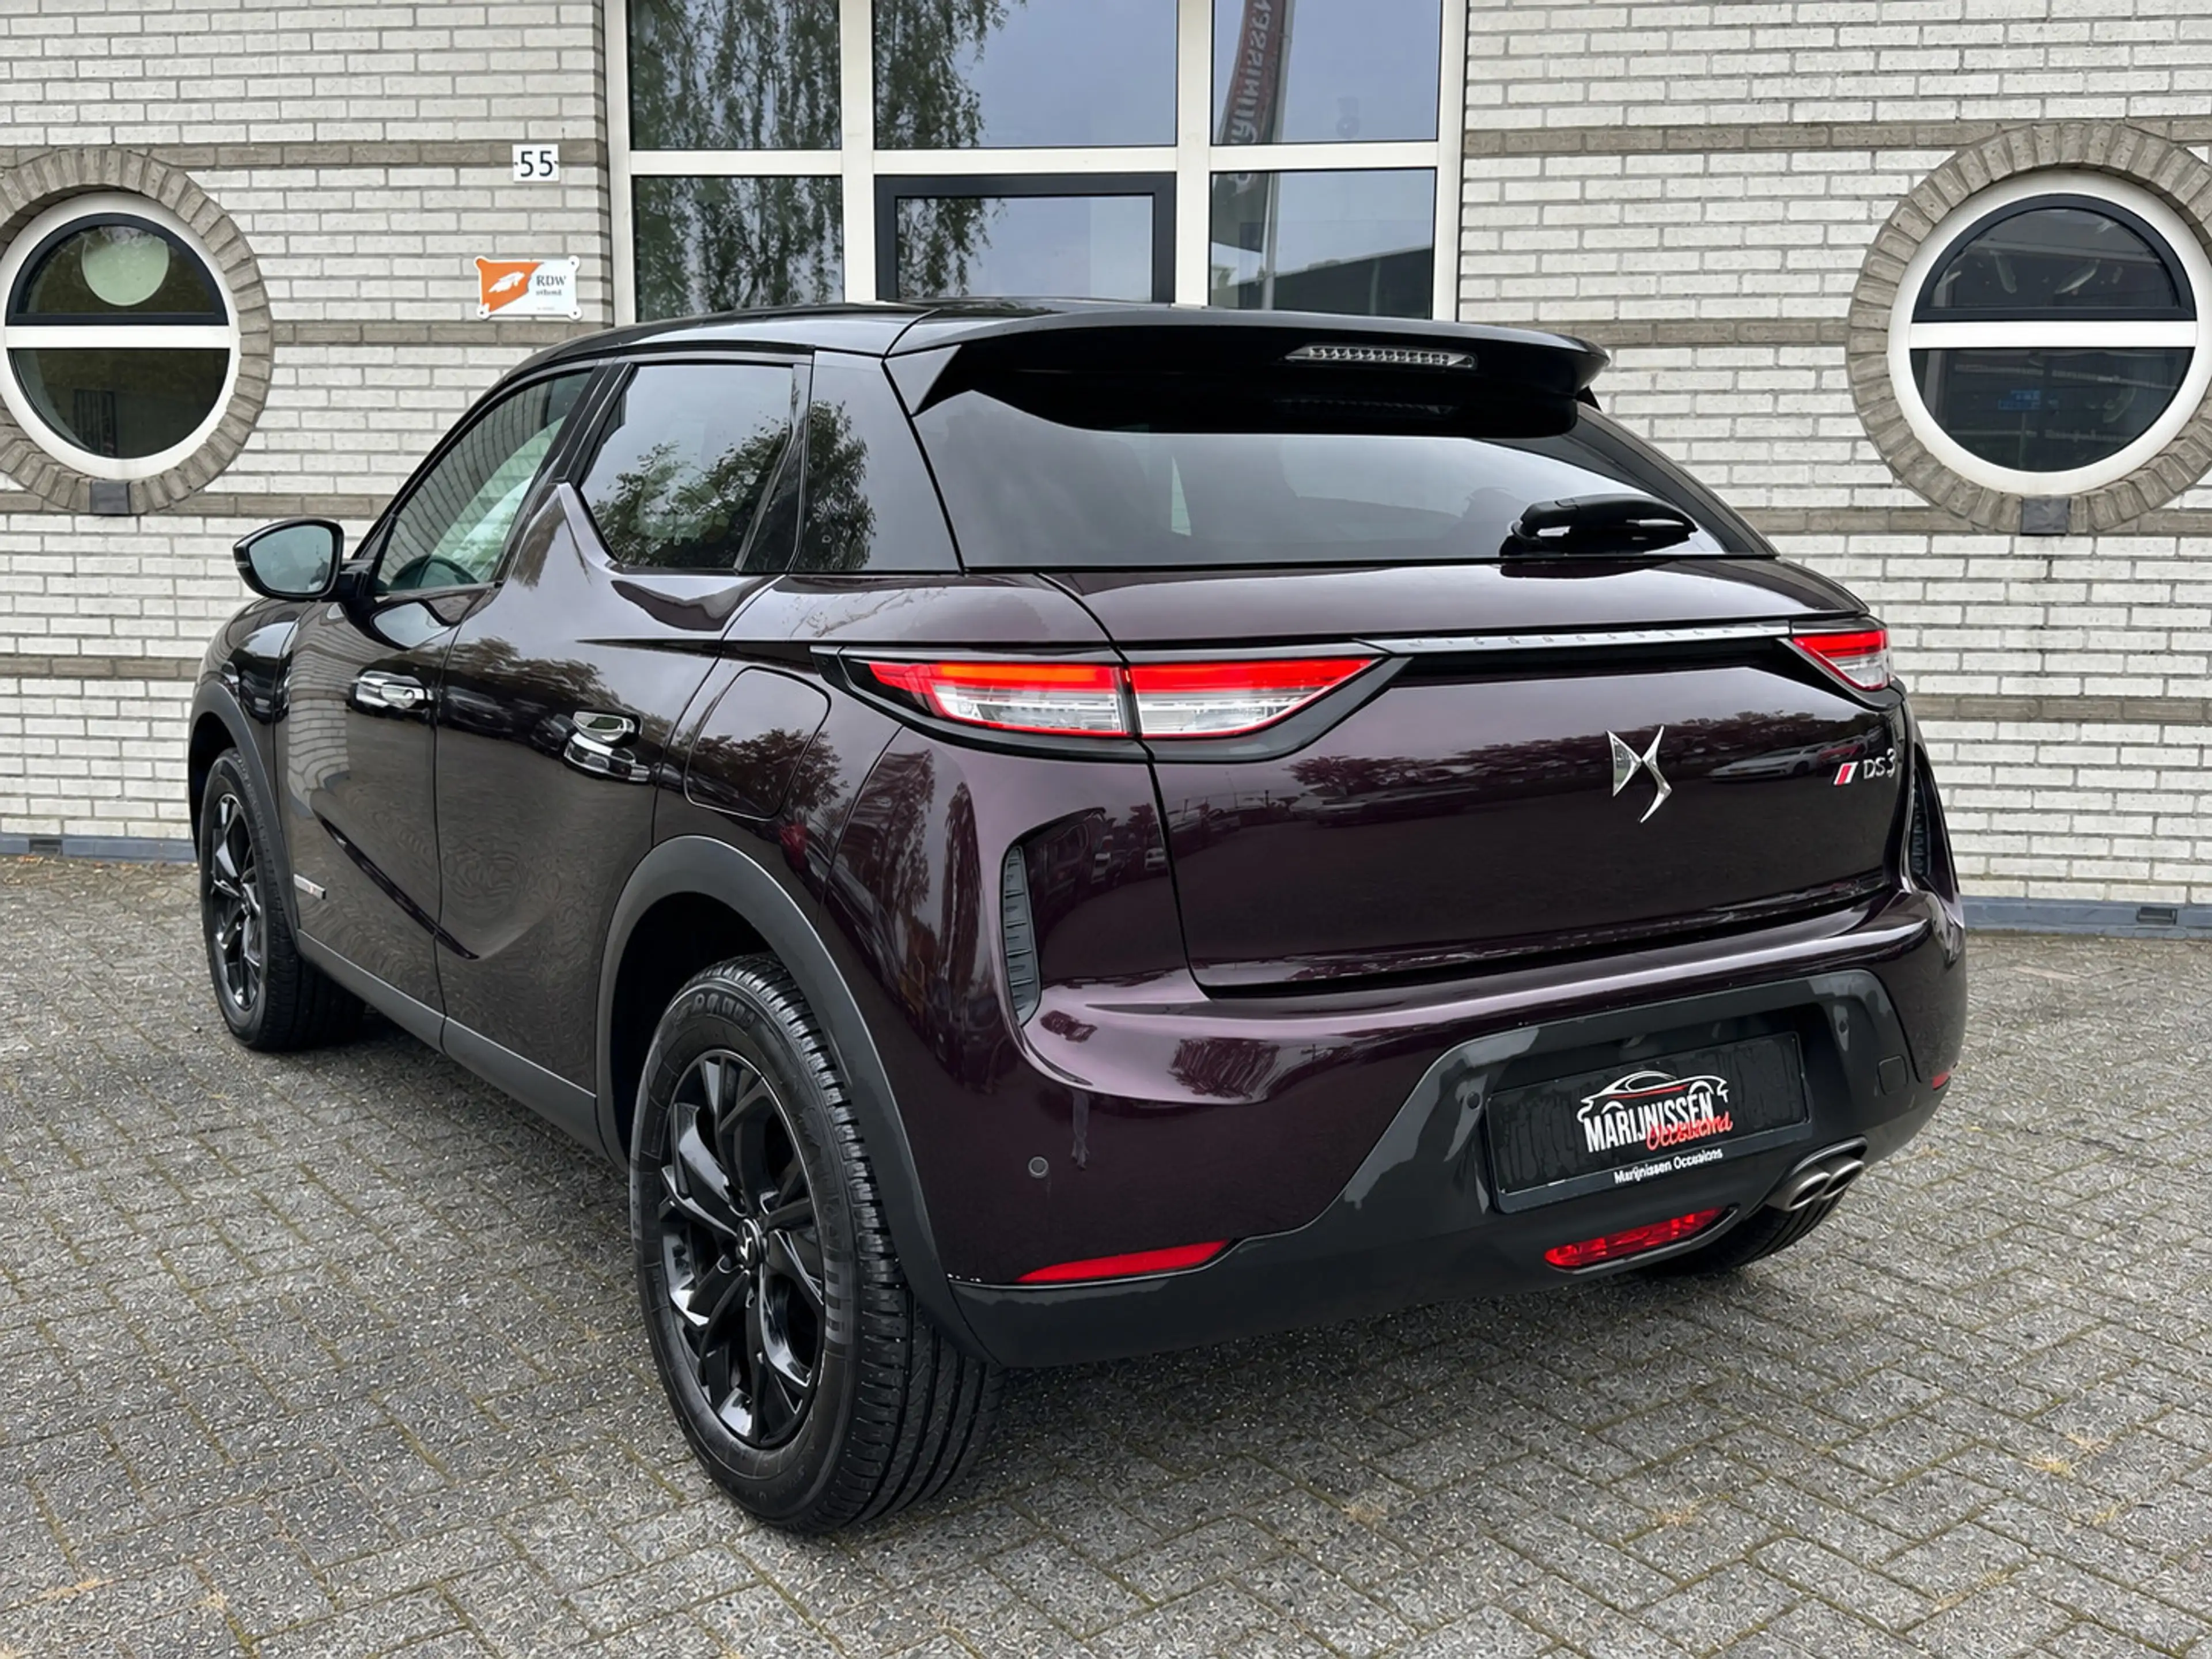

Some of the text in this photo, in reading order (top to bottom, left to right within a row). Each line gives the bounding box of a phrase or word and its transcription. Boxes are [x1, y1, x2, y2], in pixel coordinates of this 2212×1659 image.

[520, 150, 554, 177] 55
[536, 275, 567, 287] RDW
[1584, 1092, 1715, 1153] MARIJNISSEN
